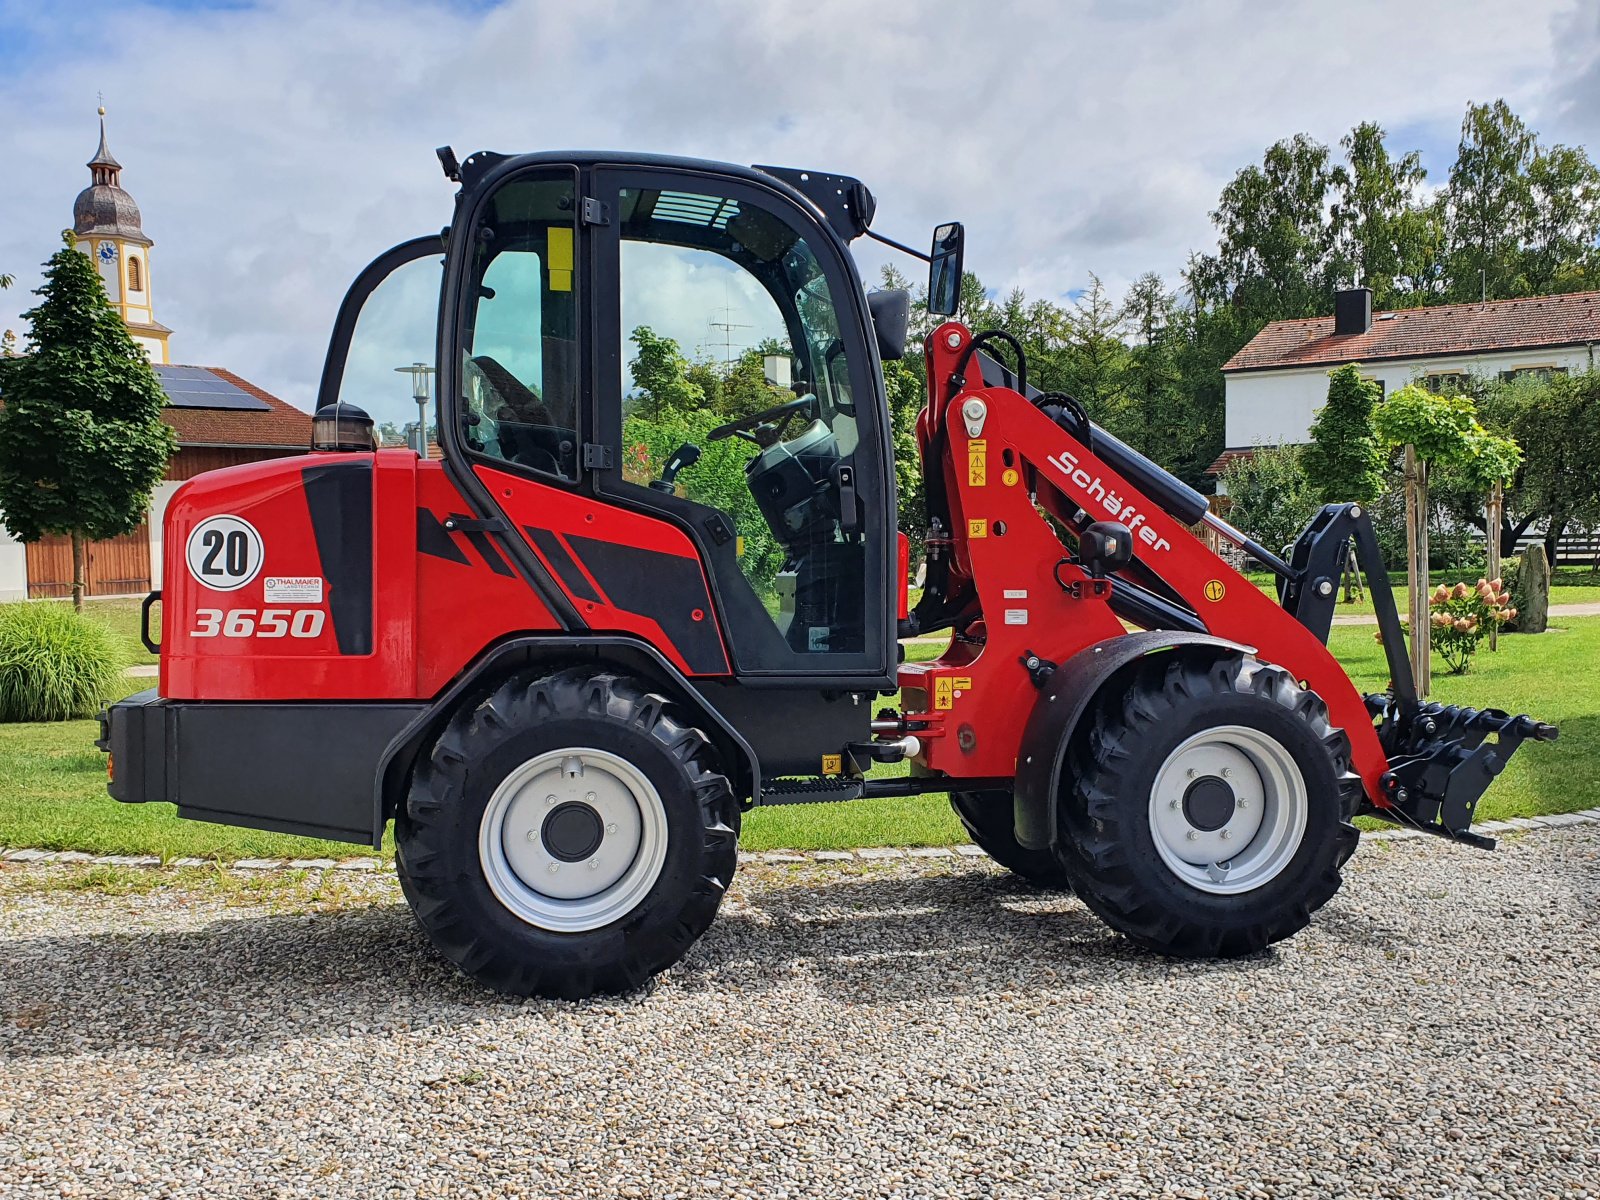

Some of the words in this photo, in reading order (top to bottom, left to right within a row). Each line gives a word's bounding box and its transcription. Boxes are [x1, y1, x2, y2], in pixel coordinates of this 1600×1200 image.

[1047, 451, 1171, 551] Schäffer
[202, 530, 248, 576] 20
[190, 609, 326, 637] 3650
